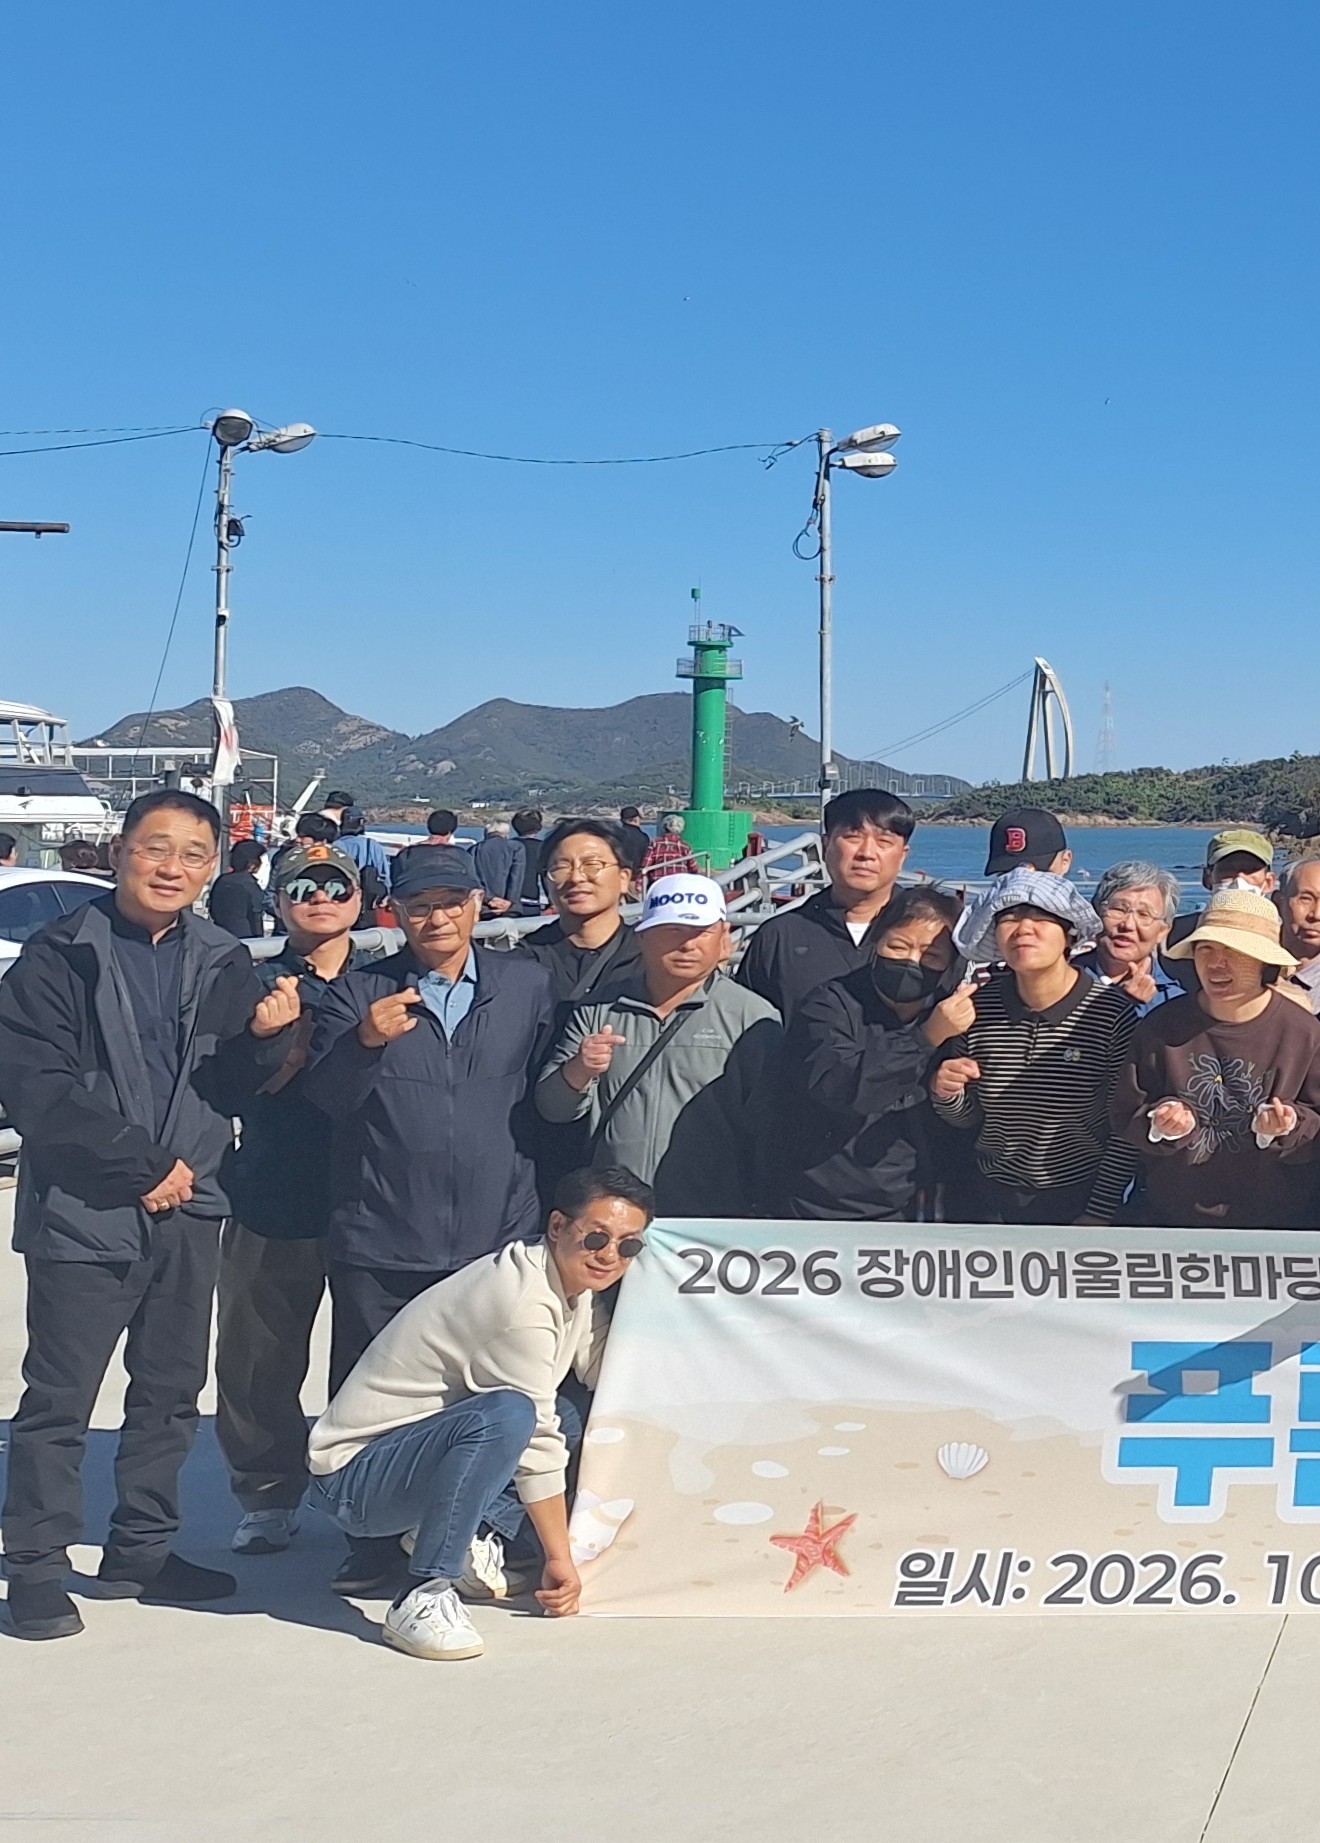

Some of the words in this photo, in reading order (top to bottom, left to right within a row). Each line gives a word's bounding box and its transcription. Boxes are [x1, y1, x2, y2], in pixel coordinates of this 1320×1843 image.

[1006, 828, 1026, 851] B
[678, 1248, 842, 1296] 2026
[894, 1551, 1031, 1606] 일시:
[1044, 1553, 1236, 1605] 2026.
